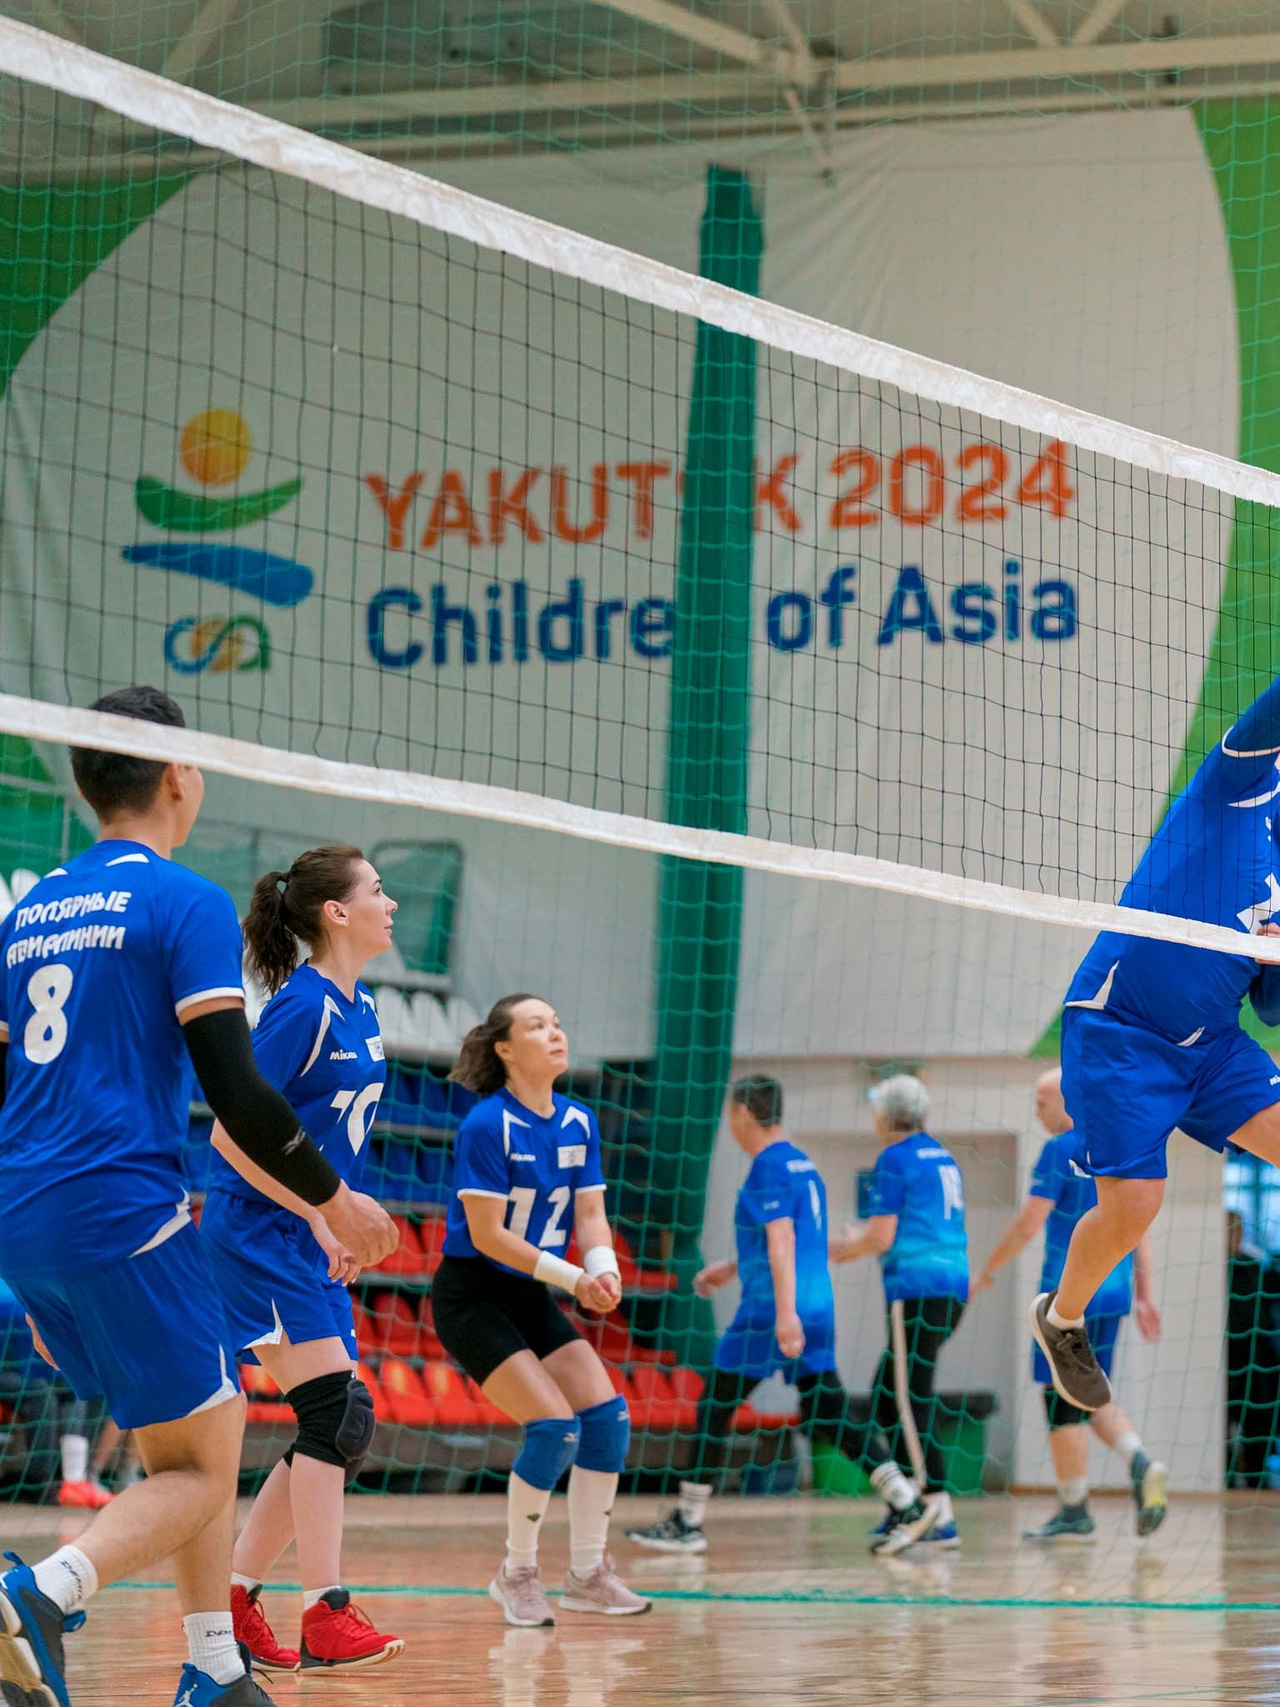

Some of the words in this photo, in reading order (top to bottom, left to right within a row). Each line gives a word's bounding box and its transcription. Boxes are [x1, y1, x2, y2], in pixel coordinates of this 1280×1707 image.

[365, 453, 802, 551] YAKUTK
[829, 440, 1074, 530] 2024
[366, 576, 676, 669] Childre
[766, 566, 856, 651] of
[876, 559, 1077, 647] Asia
[15, 890, 132, 932] ПОЛЯРНЫЕ
[23, 963, 74, 1065] 8
[508, 1185, 571, 1248] 12
